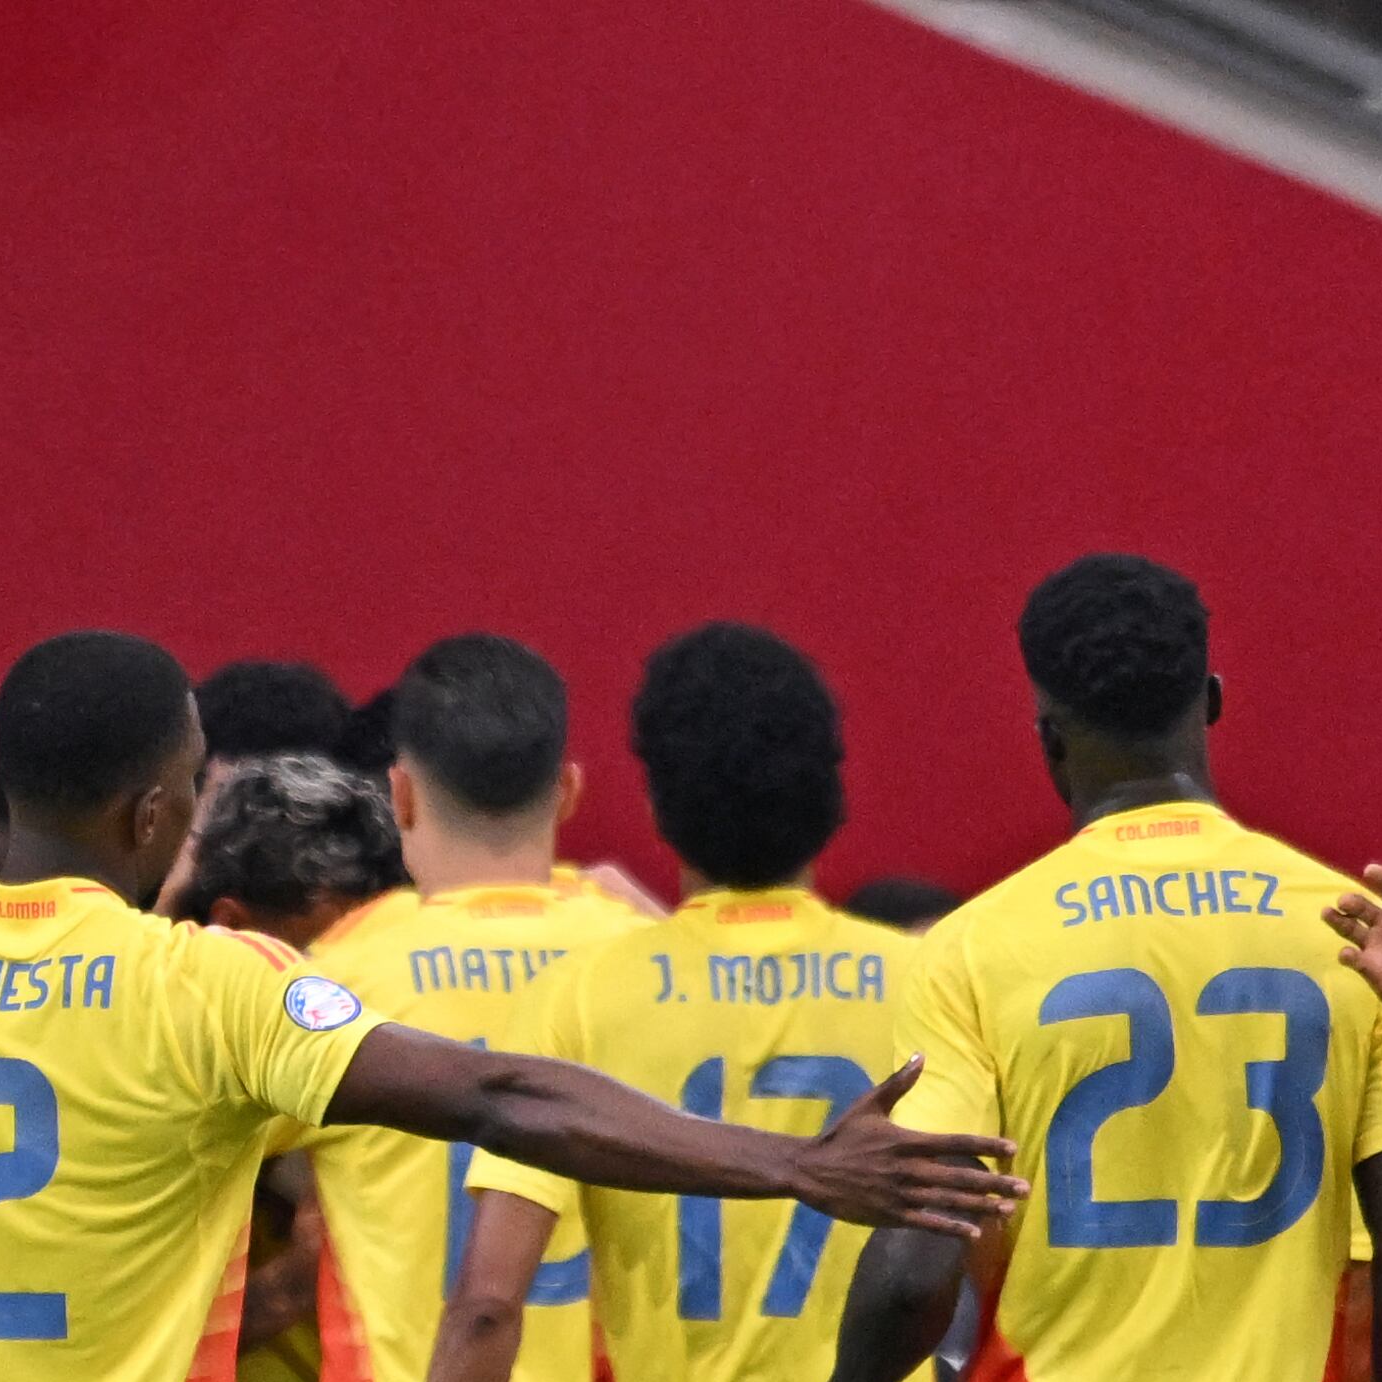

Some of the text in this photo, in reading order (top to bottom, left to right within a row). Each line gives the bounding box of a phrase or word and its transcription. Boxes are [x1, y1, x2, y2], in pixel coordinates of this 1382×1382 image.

[1115, 819, 1201, 842] COLOMBIA
[1054, 869, 1285, 928] SANCHEZ
[651, 951, 886, 1005] J. MOJICA
[1038, 967, 1330, 1248] 23
[677, 1055, 877, 1321] 17
